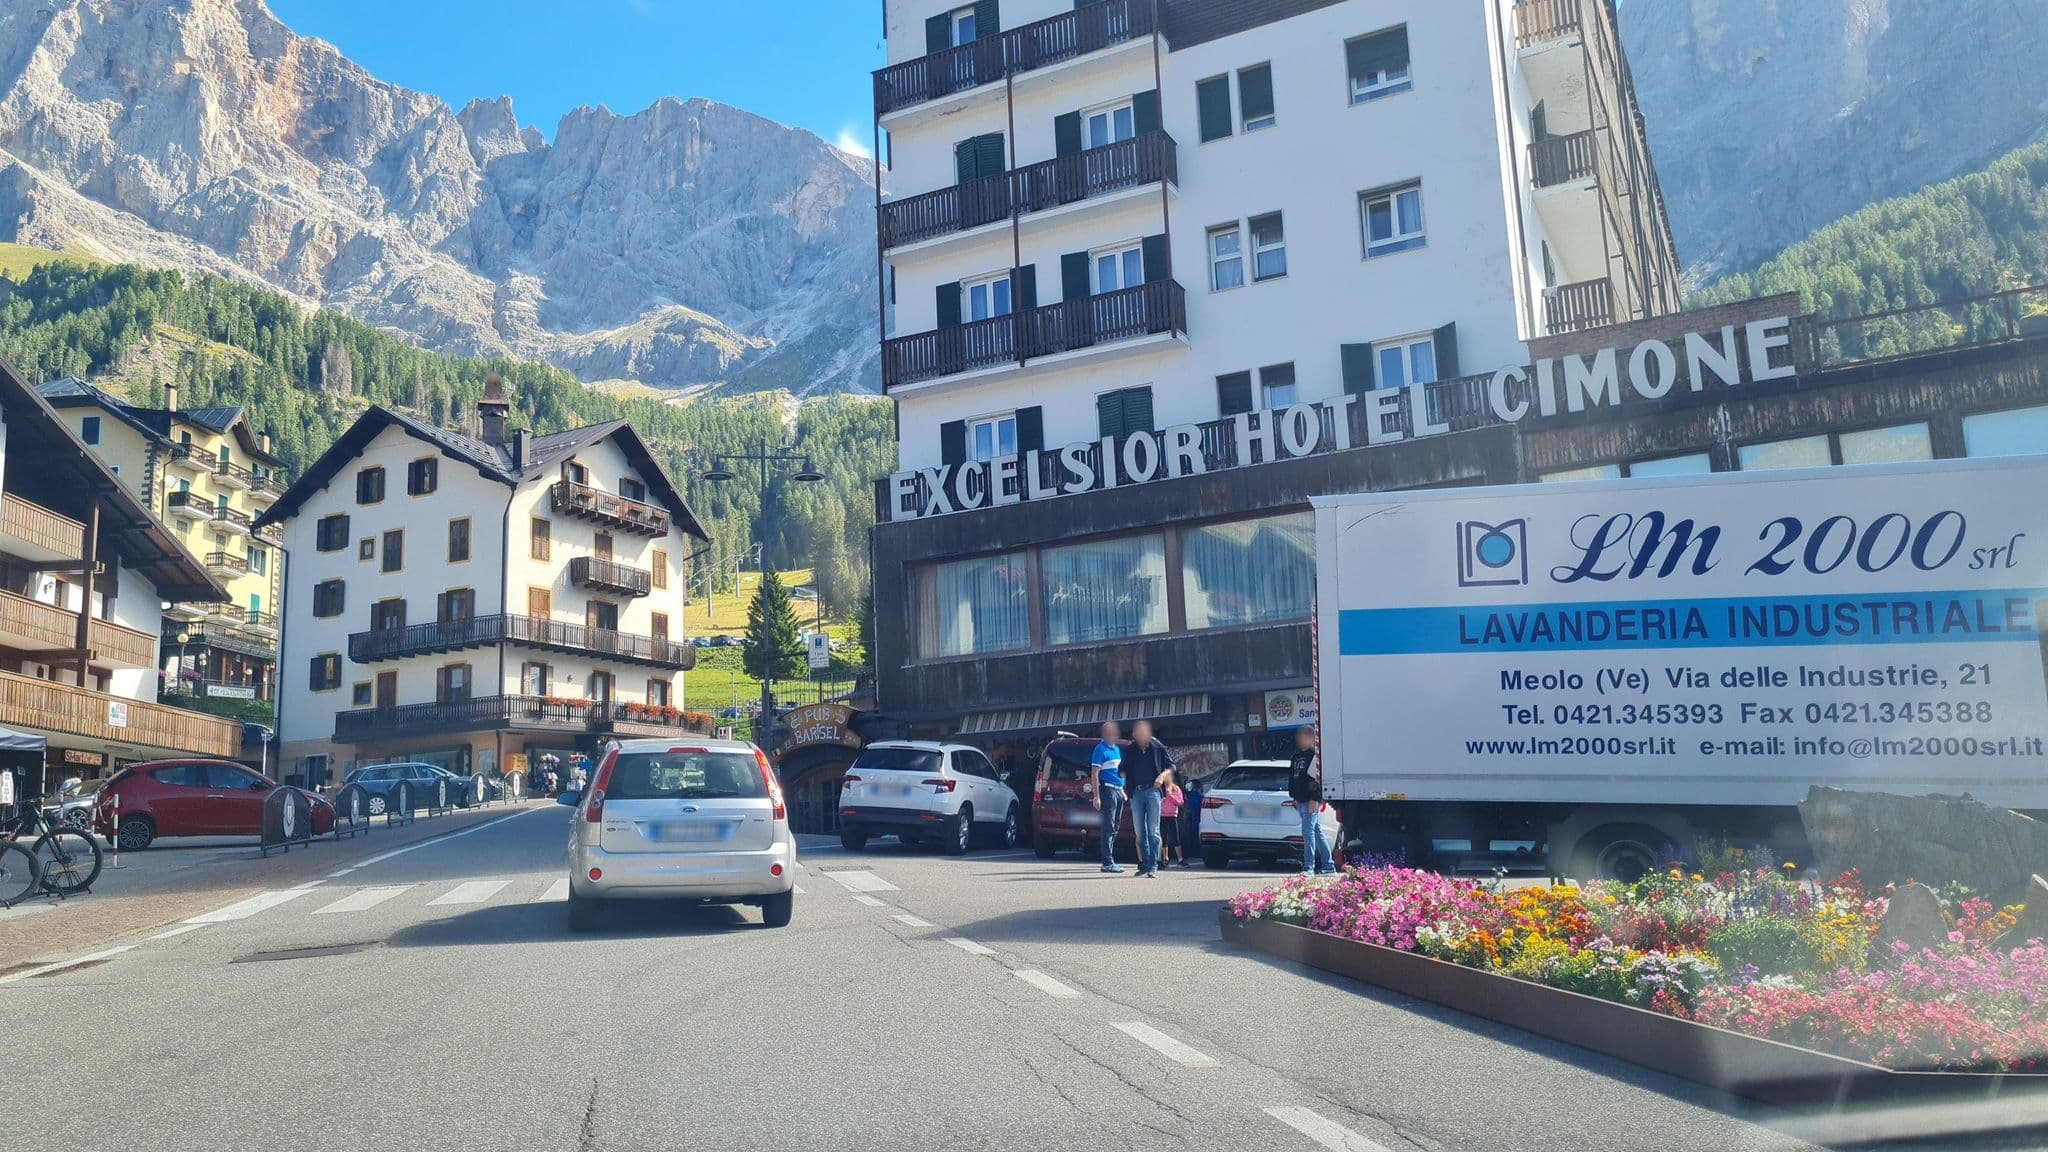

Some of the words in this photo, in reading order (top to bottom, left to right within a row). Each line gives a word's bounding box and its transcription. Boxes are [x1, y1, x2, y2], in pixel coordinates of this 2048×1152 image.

[889, 423, 1206, 522] EXCELSIOR
[1234, 382, 1450, 466] HOTEL
[1490, 316, 1796, 422] CIMONE
[1744, 510, 1967, 577] 2000
[1968, 533, 2026, 570] srl
[1459, 607, 1709, 645] LAVANDERIA
[1728, 597, 2033, 639] INDUSTRIALE
[1501, 669, 1584, 690] Meolo
[1596, 668, 1650, 694] (Ve)
[1665, 667, 1711, 689] Via
[1720, 666, 1788, 688] delle
[1799, 664, 1948, 690] Industrie,
[1959, 663, 1991, 685] 21
[804, 707, 830, 722] PUB
[1502, 704, 1545, 724] Tel.
[1554, 703, 1724, 724] 0421.345393
[1741, 703, 1794, 724] Fax
[1805, 701, 1993, 724] 0421.345388
[1465, 737, 1676, 755] www.lm2000srl.it
[1699, 736, 1785, 755] e-mail:
[1794, 736, 2044, 758] info@lm2000srl.it
